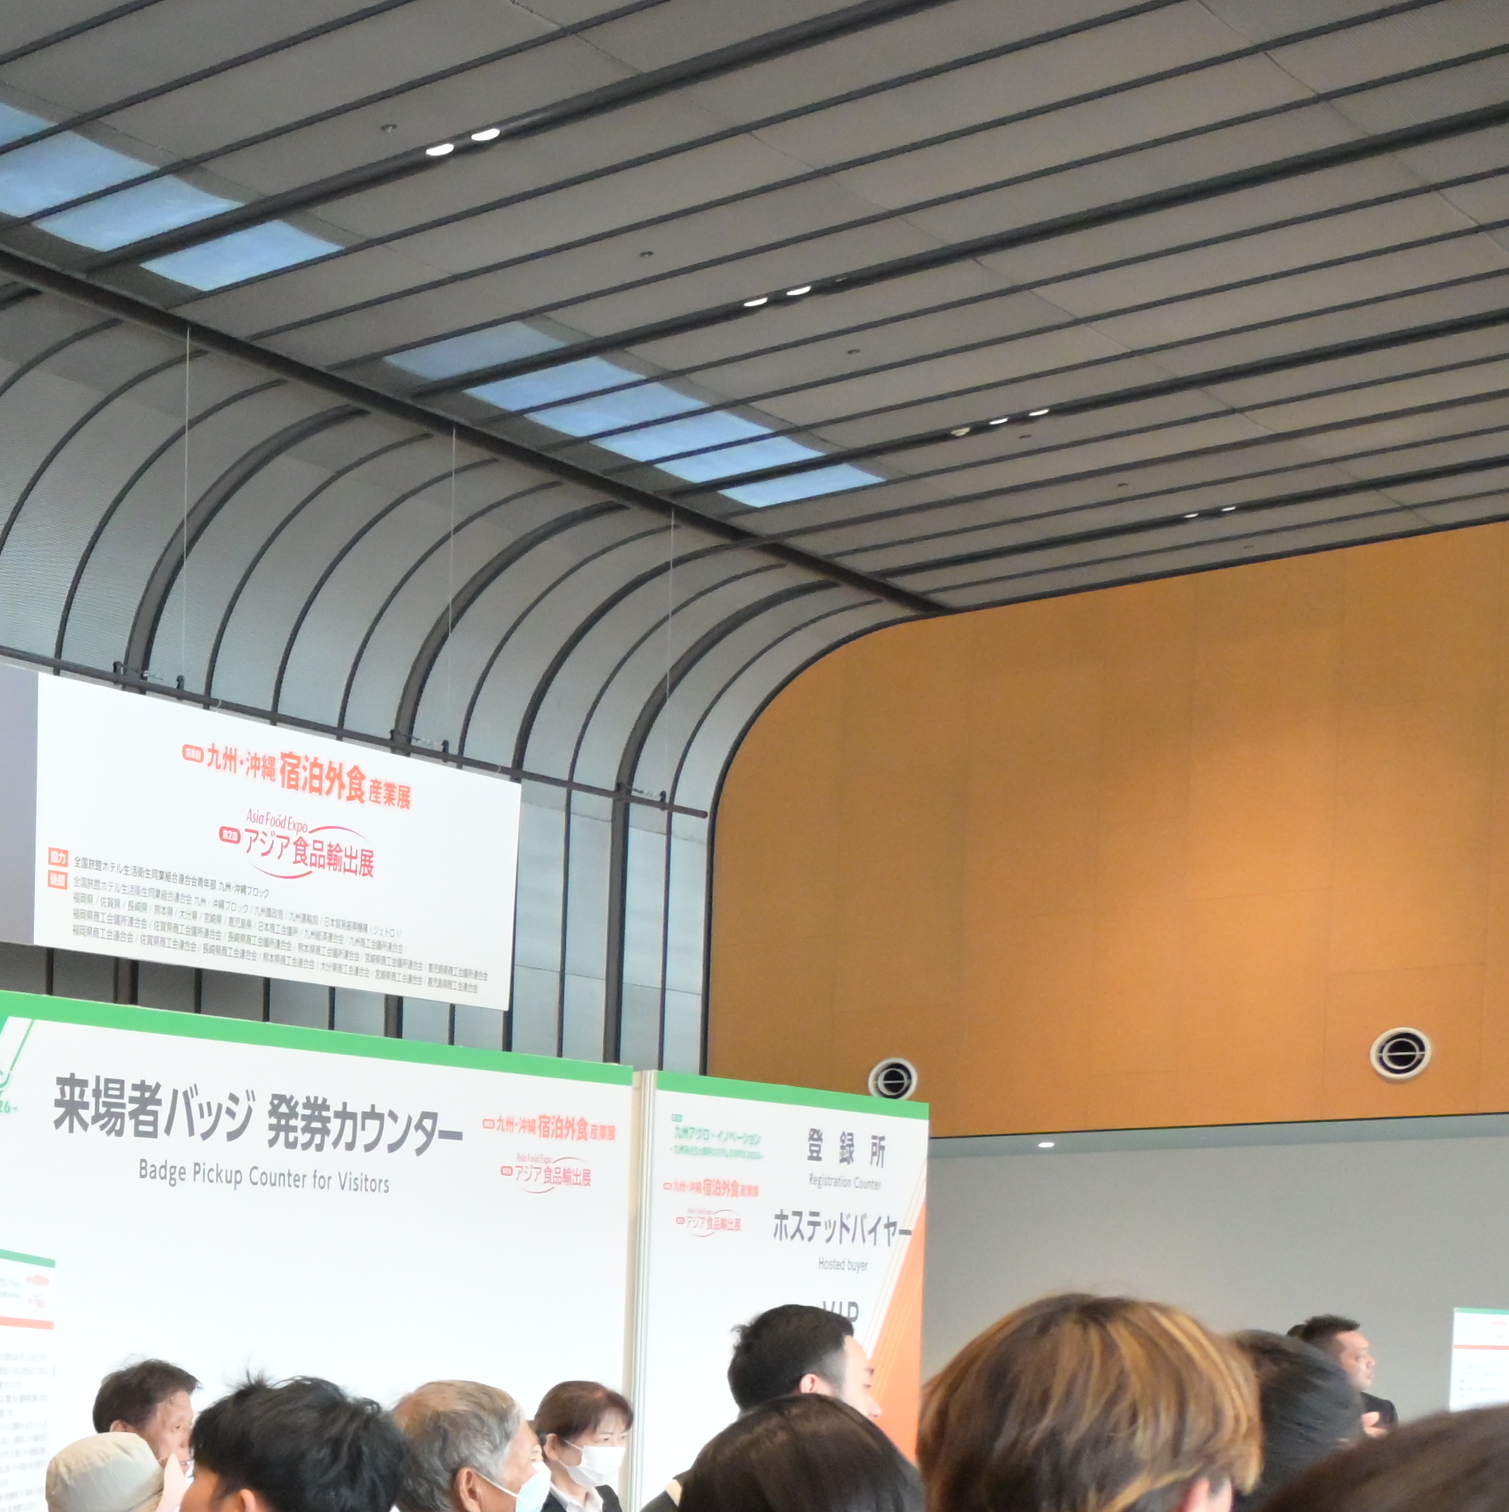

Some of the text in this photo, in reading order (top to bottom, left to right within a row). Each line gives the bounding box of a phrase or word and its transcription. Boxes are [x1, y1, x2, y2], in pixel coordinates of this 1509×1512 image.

[246, 808, 264, 825] Asia
[288, 818, 308, 836] Expo
[245, 828, 374, 878] アジア食品輸出展
[54, 1072, 464, 1157] 来場者バッジ 発券カウンター
[139, 1158, 390, 1194] Badge Pickup Counter for Visitors
[809, 1173, 881, 1190] Registration Counter
[773, 1208, 912, 1247] ホステッドバイヤー
[818, 1257, 869, 1274] Hosted buyer
